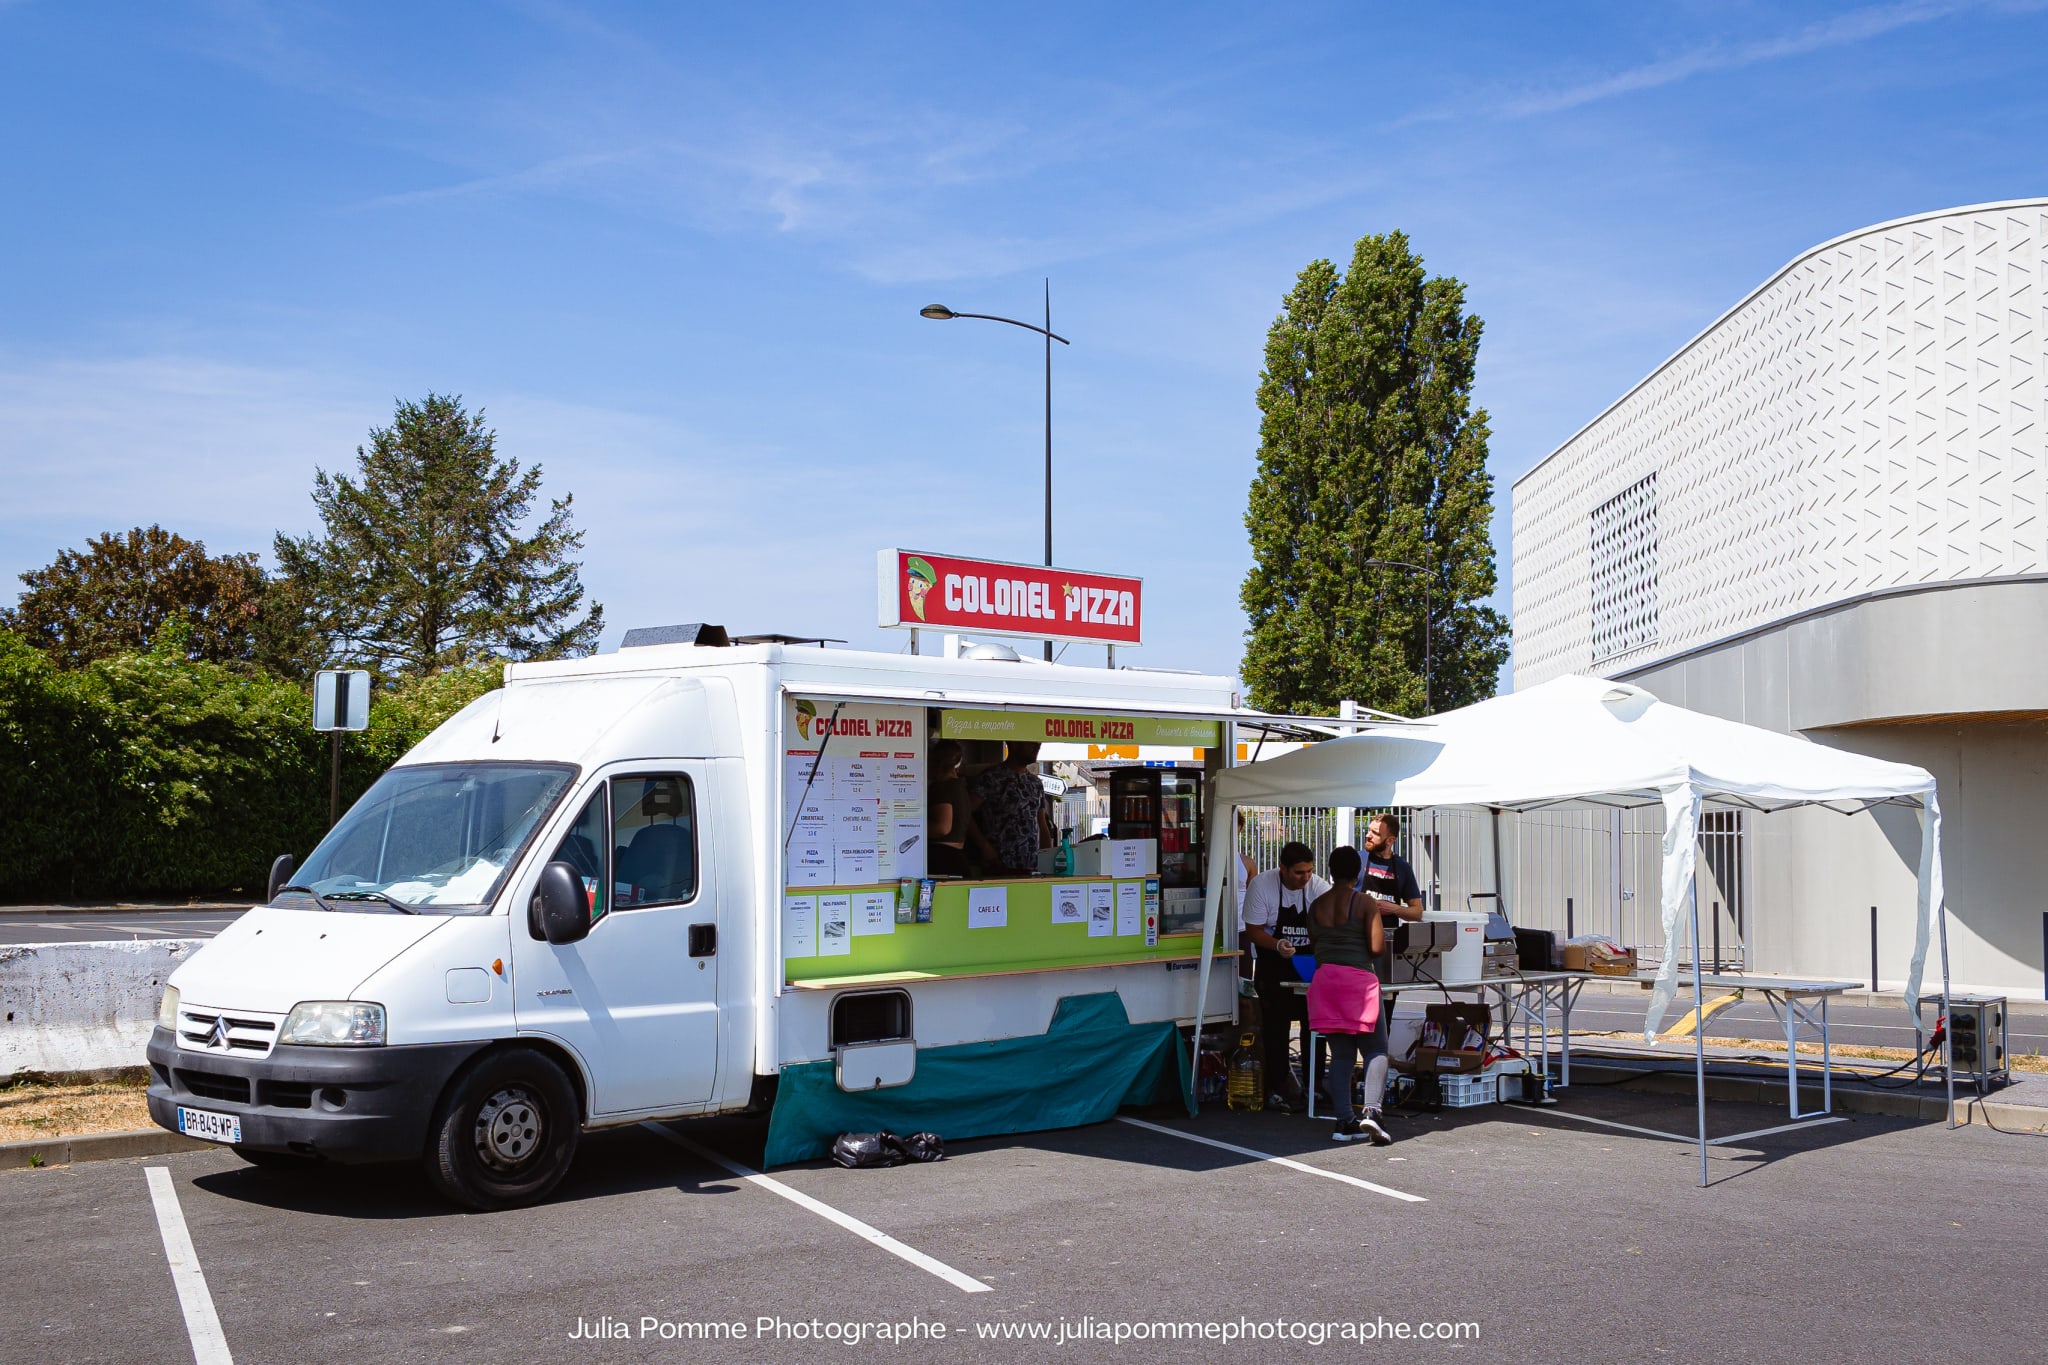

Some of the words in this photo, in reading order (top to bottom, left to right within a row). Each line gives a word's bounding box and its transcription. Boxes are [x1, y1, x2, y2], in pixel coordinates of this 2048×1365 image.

[944, 574, 1056, 620] COLONEL
[1065, 585, 1134, 627] PIZZA
[816, 718, 871, 737] COLONEL
[876, 719, 912, 737] PIZZA
[946, 716, 972, 734] Pizzas
[981, 720, 1016, 733] emporter
[1045, 718, 1096, 738] COLONEL
[1101, 721, 1134, 739] PIZZA
[1282, 926, 1309, 936] COLON
[1172, 963, 1199, 971] Euromag
[185, 1111, 232, 1137] BR-849-WP
